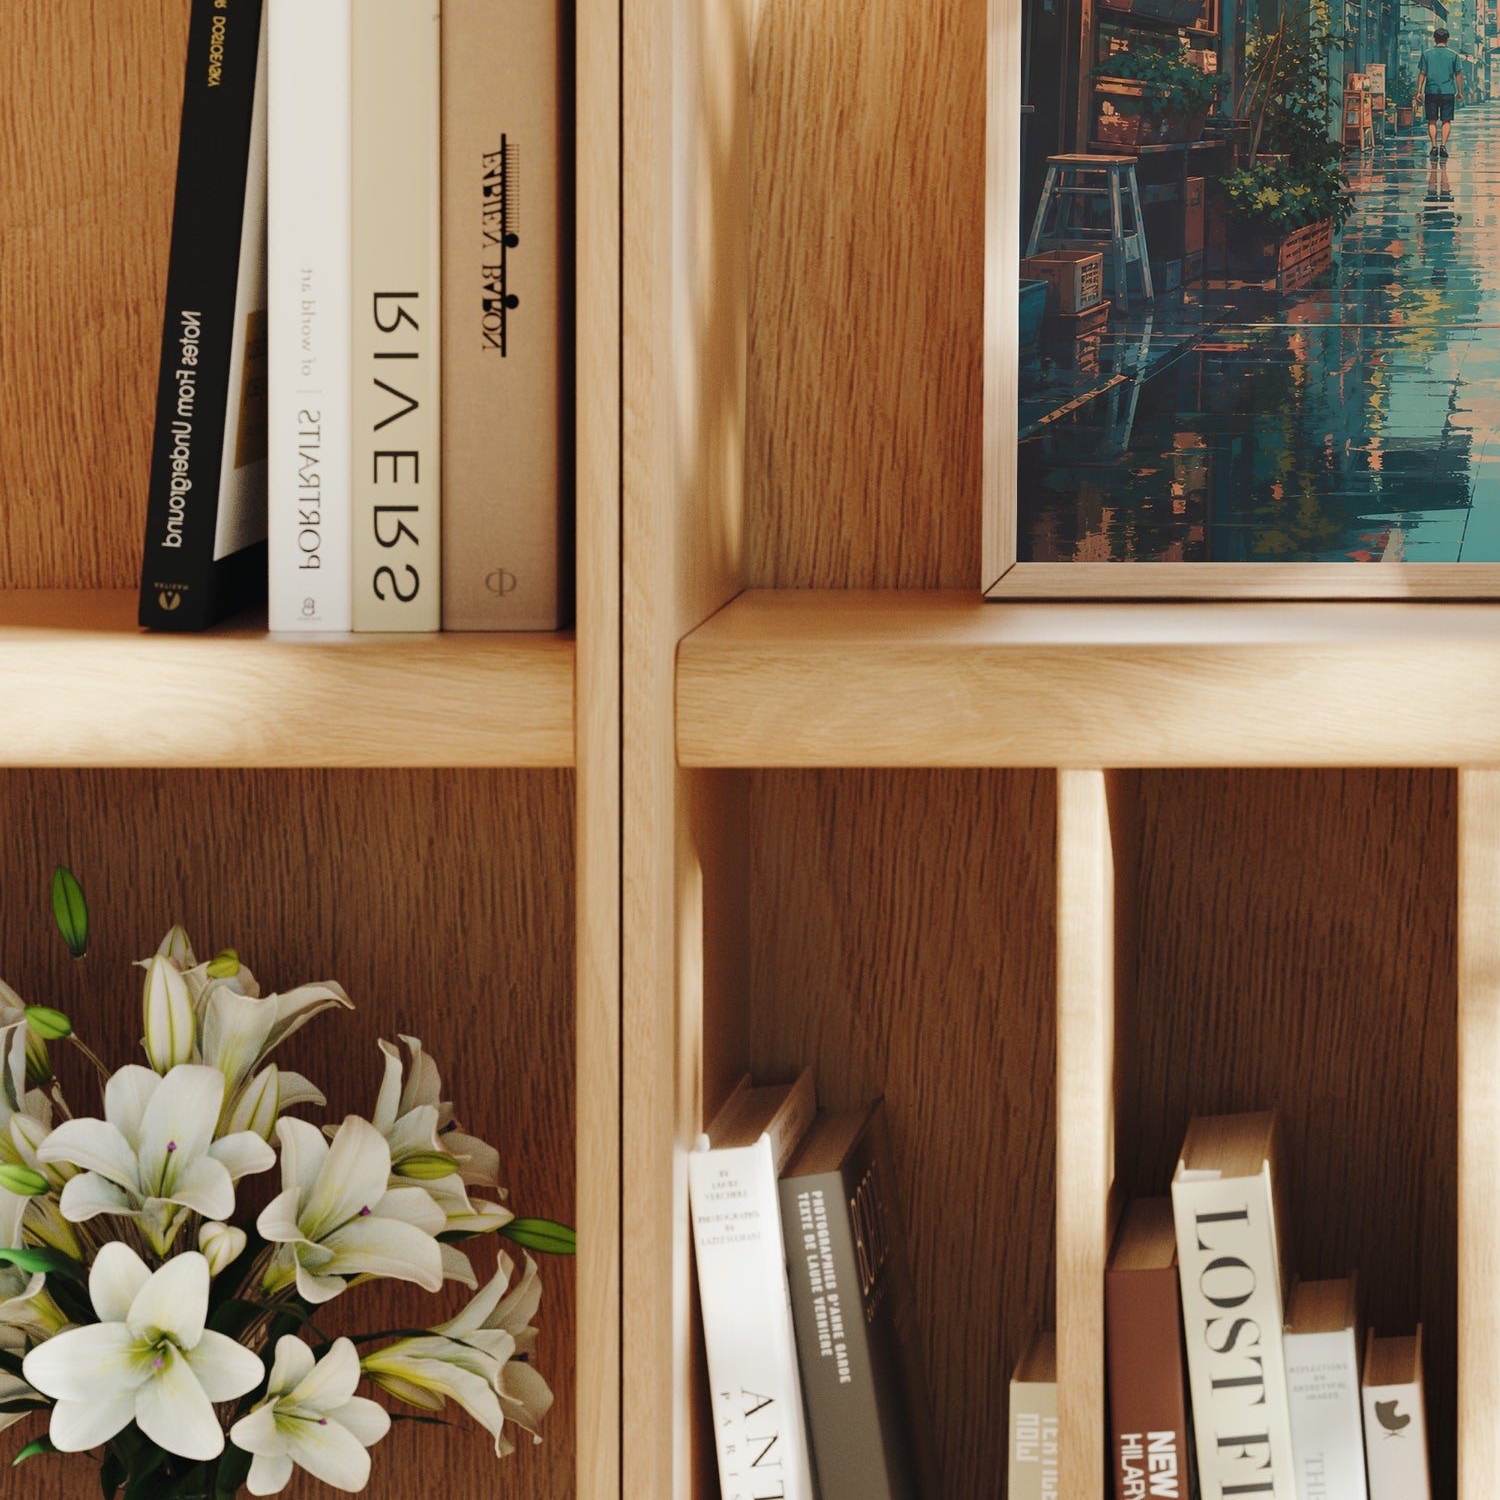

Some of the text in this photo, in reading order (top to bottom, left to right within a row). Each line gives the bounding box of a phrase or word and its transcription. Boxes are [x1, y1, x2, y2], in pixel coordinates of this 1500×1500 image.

[797, 1191, 833, 1357] TEXTE DE LAURE VERNIERE
[811, 1190, 852, 1384] PHOTOGRAPHIES D'ANNE GARDE
[1194, 1204, 1267, 1406] LOST
[1147, 1430, 1179, 1499] NEW
